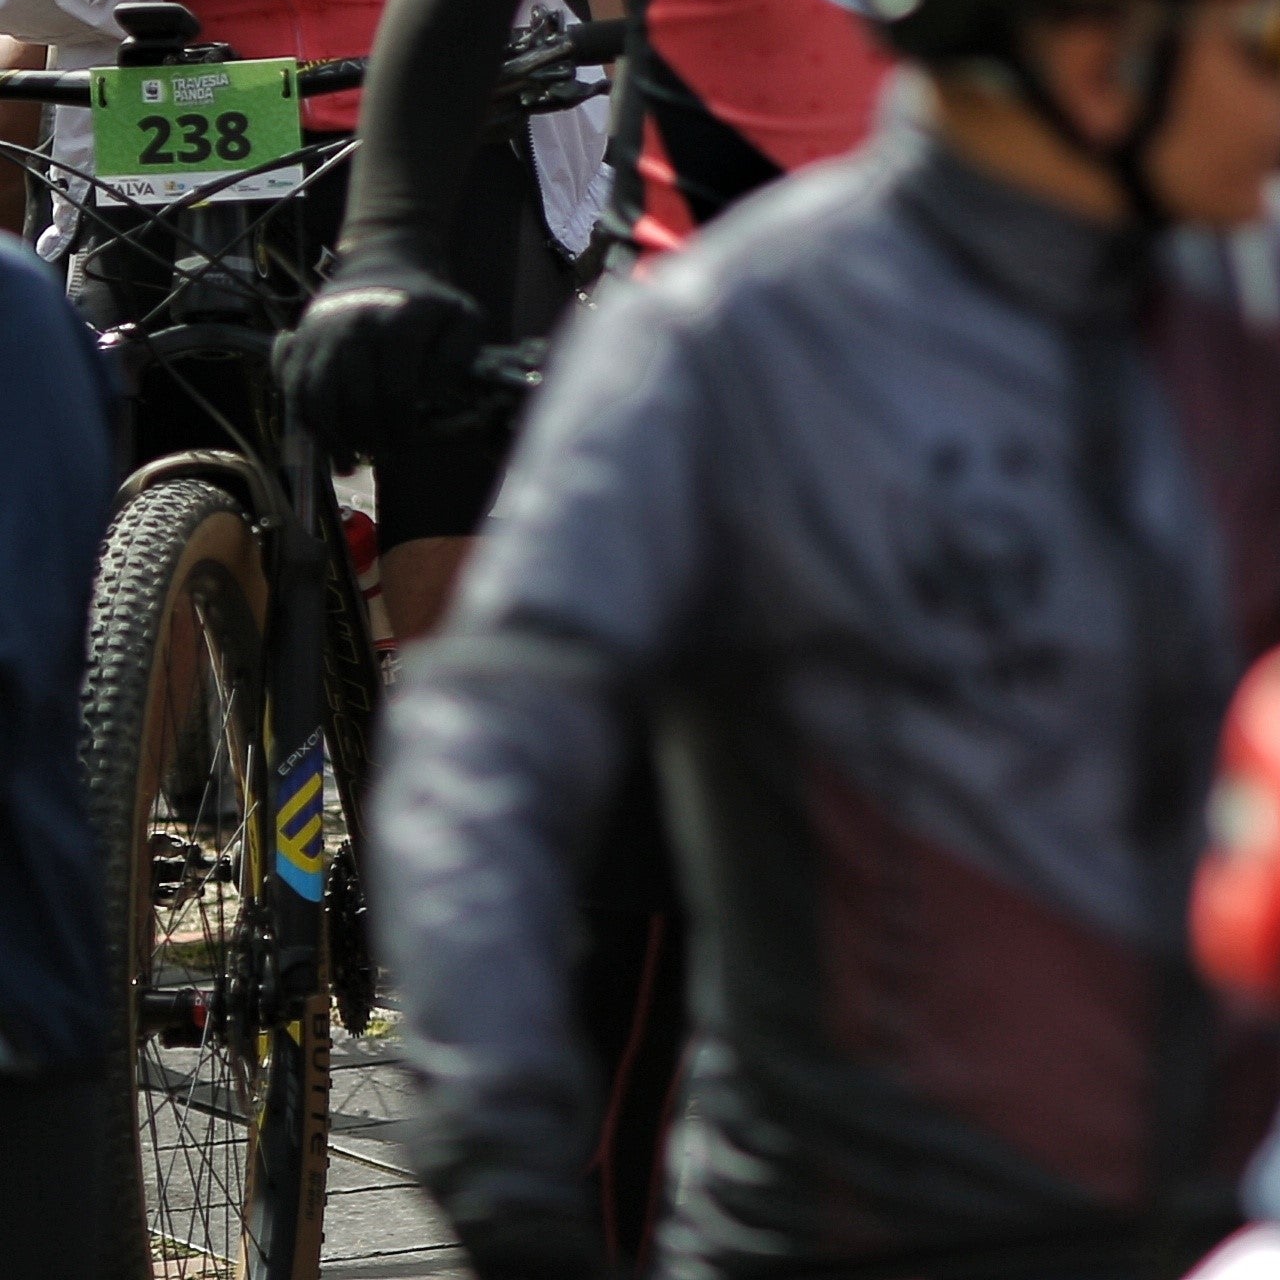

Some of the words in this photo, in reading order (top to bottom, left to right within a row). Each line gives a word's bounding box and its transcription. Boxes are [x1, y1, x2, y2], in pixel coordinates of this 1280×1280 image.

[171, 73, 231, 90] TRAVESIA
[172, 88, 215, 102] PANDA
[136, 111, 252, 166] 238
